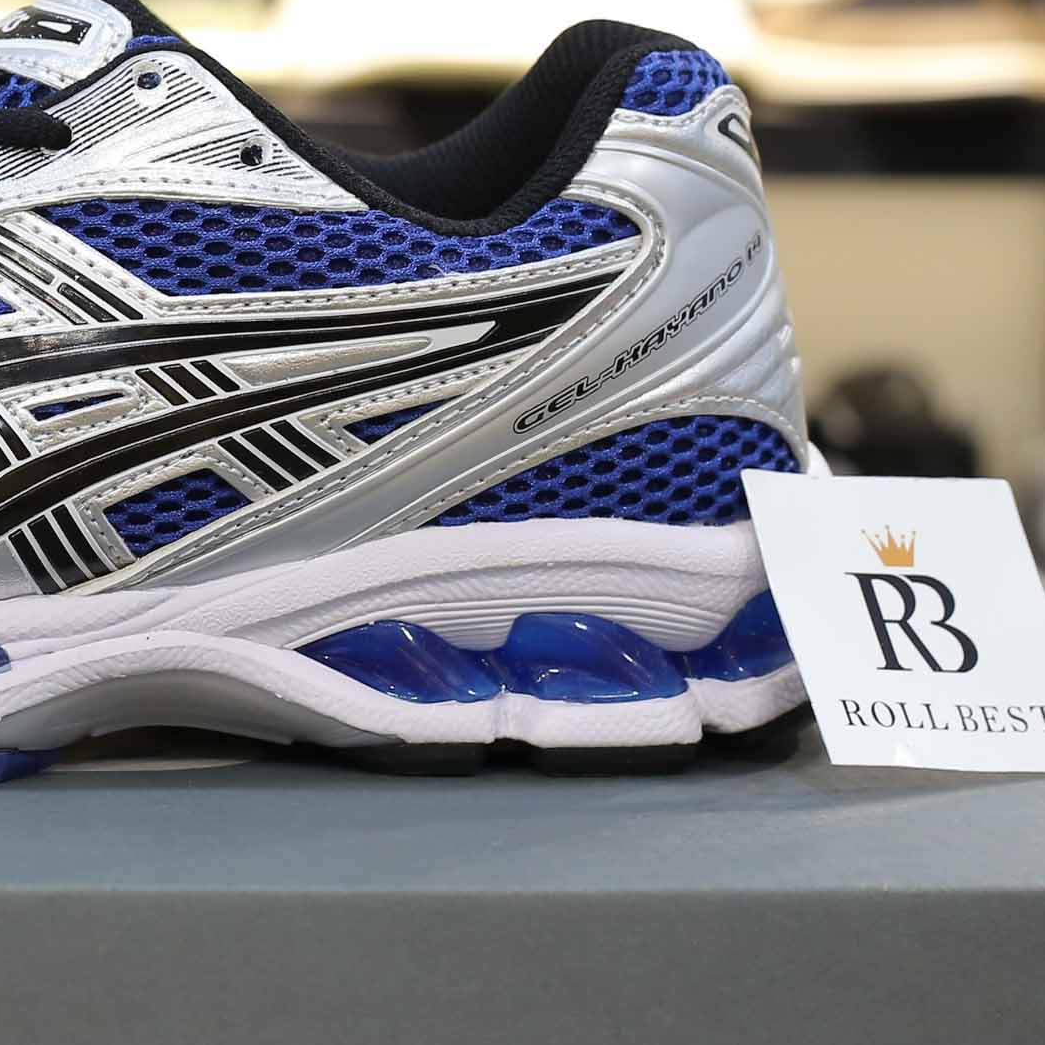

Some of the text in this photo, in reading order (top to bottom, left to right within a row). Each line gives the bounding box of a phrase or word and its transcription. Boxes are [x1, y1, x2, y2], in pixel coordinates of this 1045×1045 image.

[513, 258, 743, 434] GEL-KAYANO
[845, 572, 978, 673] RB
[840, 699, 949, 731] ROLL
